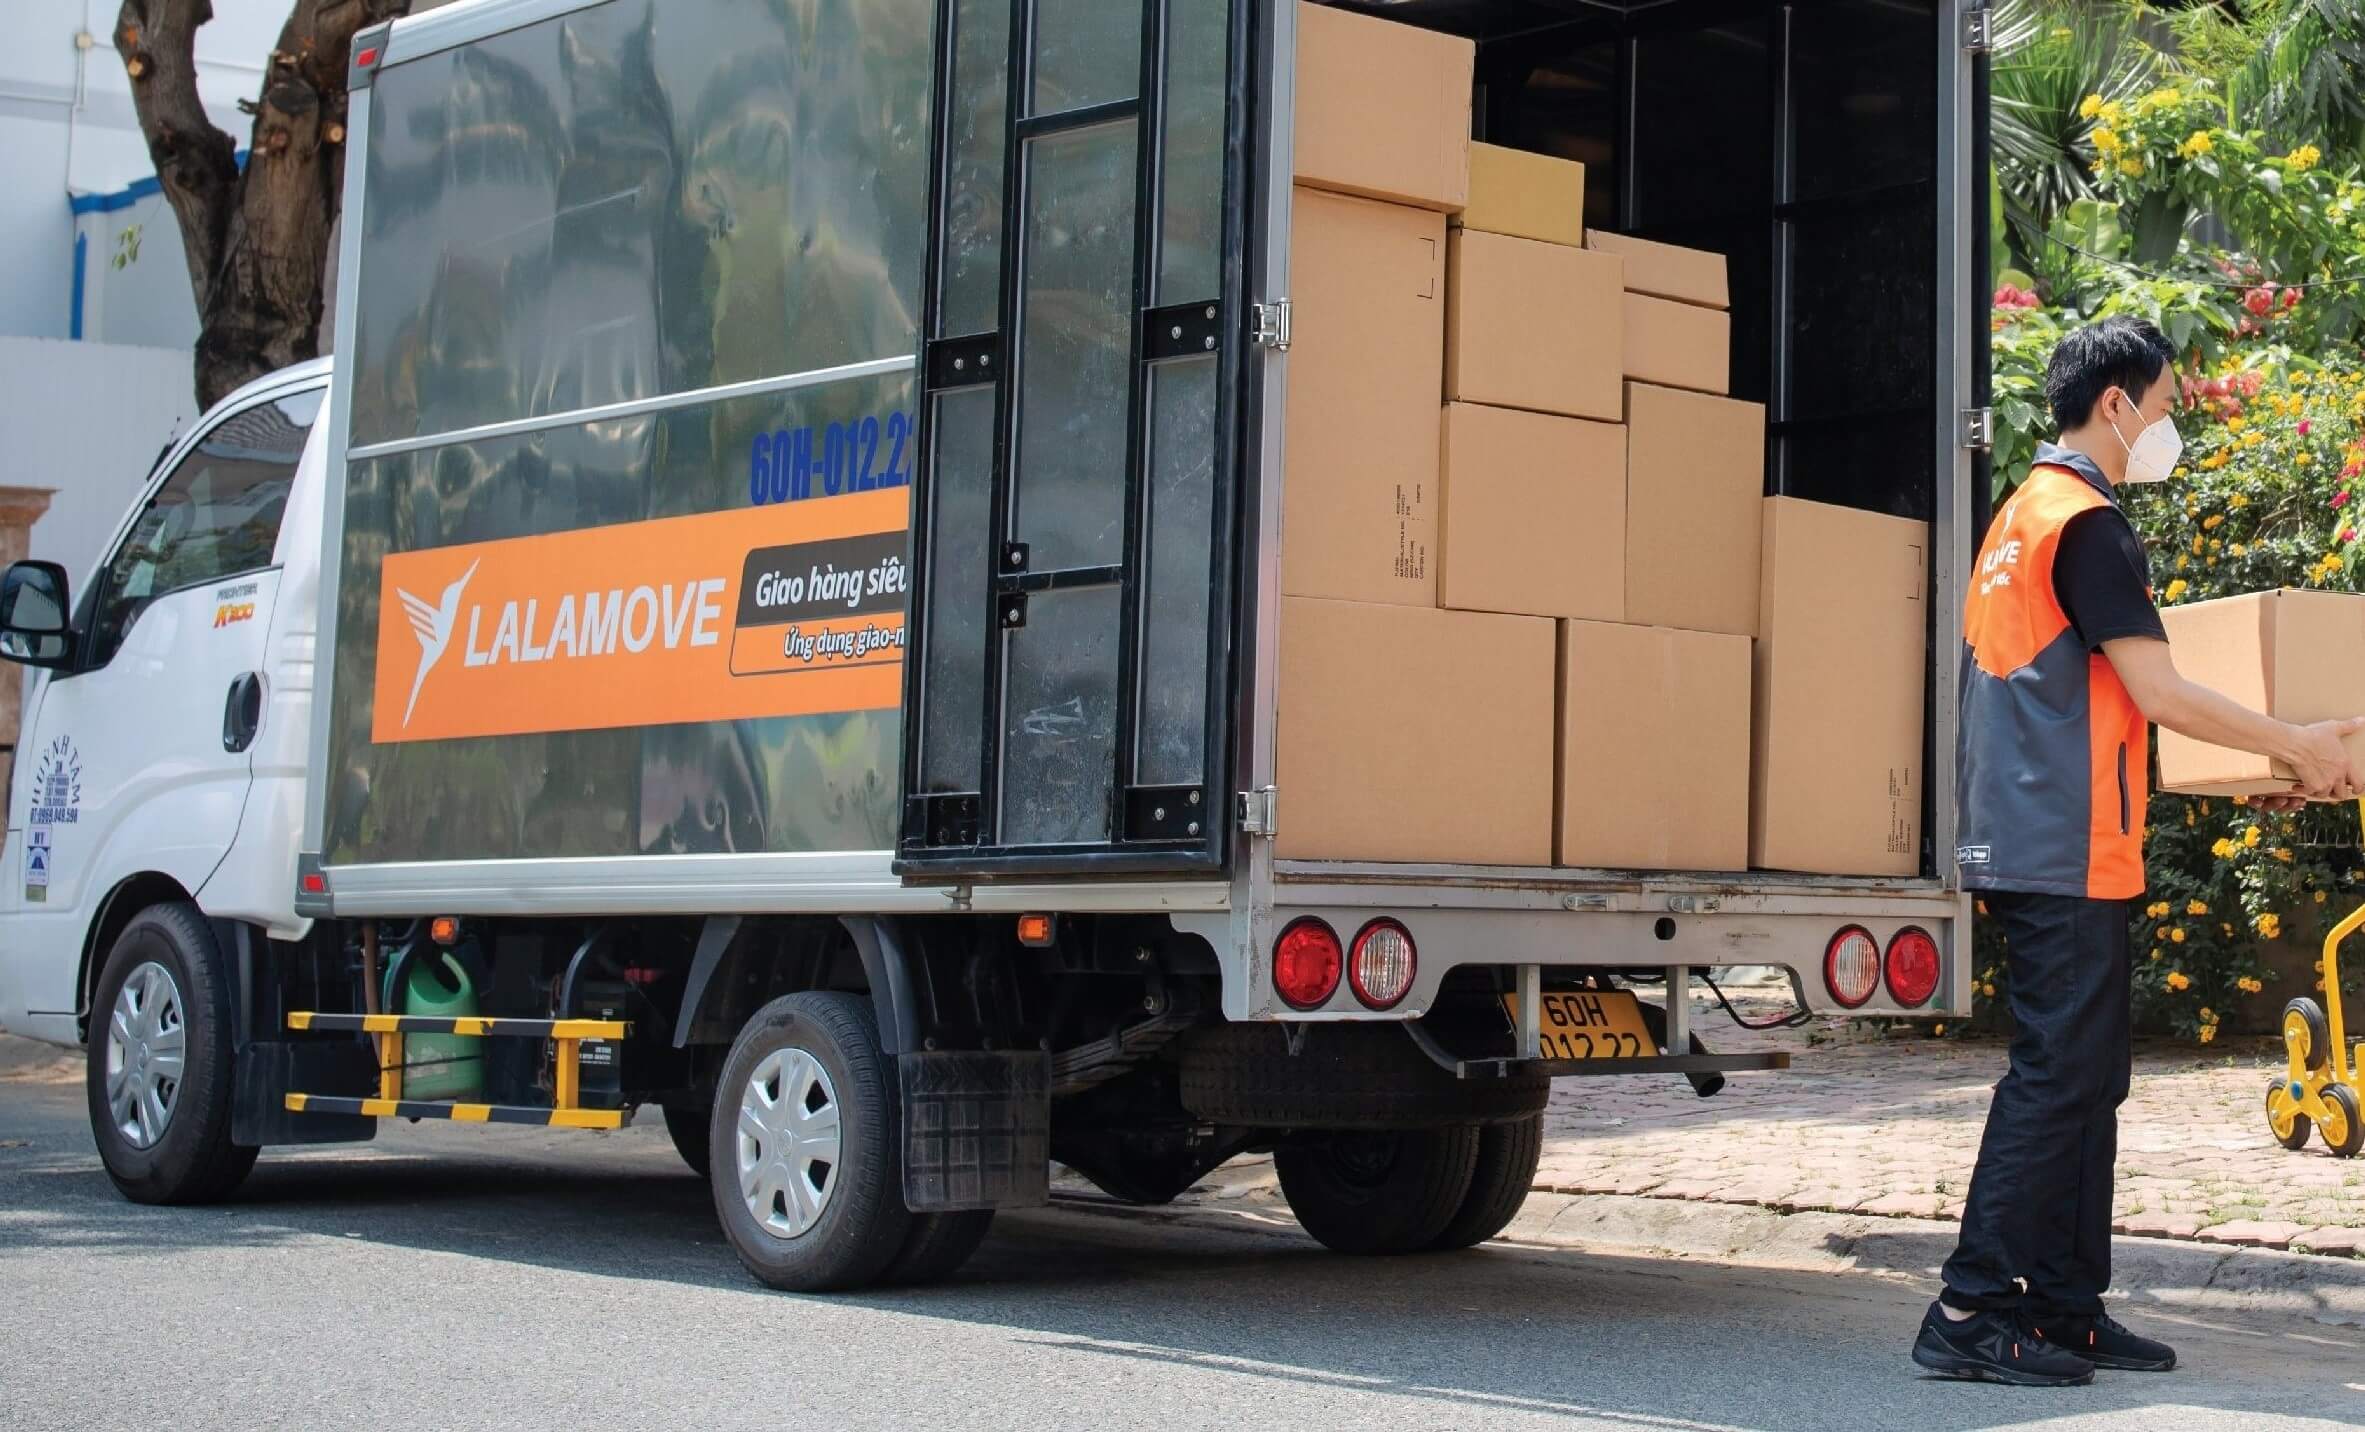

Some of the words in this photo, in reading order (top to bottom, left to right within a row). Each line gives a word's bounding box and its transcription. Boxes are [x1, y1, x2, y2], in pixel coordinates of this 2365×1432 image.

[750, 411, 911, 506] 60H-012.2
[755, 569, 804, 606] Giao
[808, 563, 864, 608] hàng
[464, 578, 726, 667] LALAMOVE
[783, 626, 813, 661] Ứng
[816, 627, 855, 661] dụng
[1543, 994, 1609, 1027] 60H
[1540, 1032, 1641, 1058] 01222
